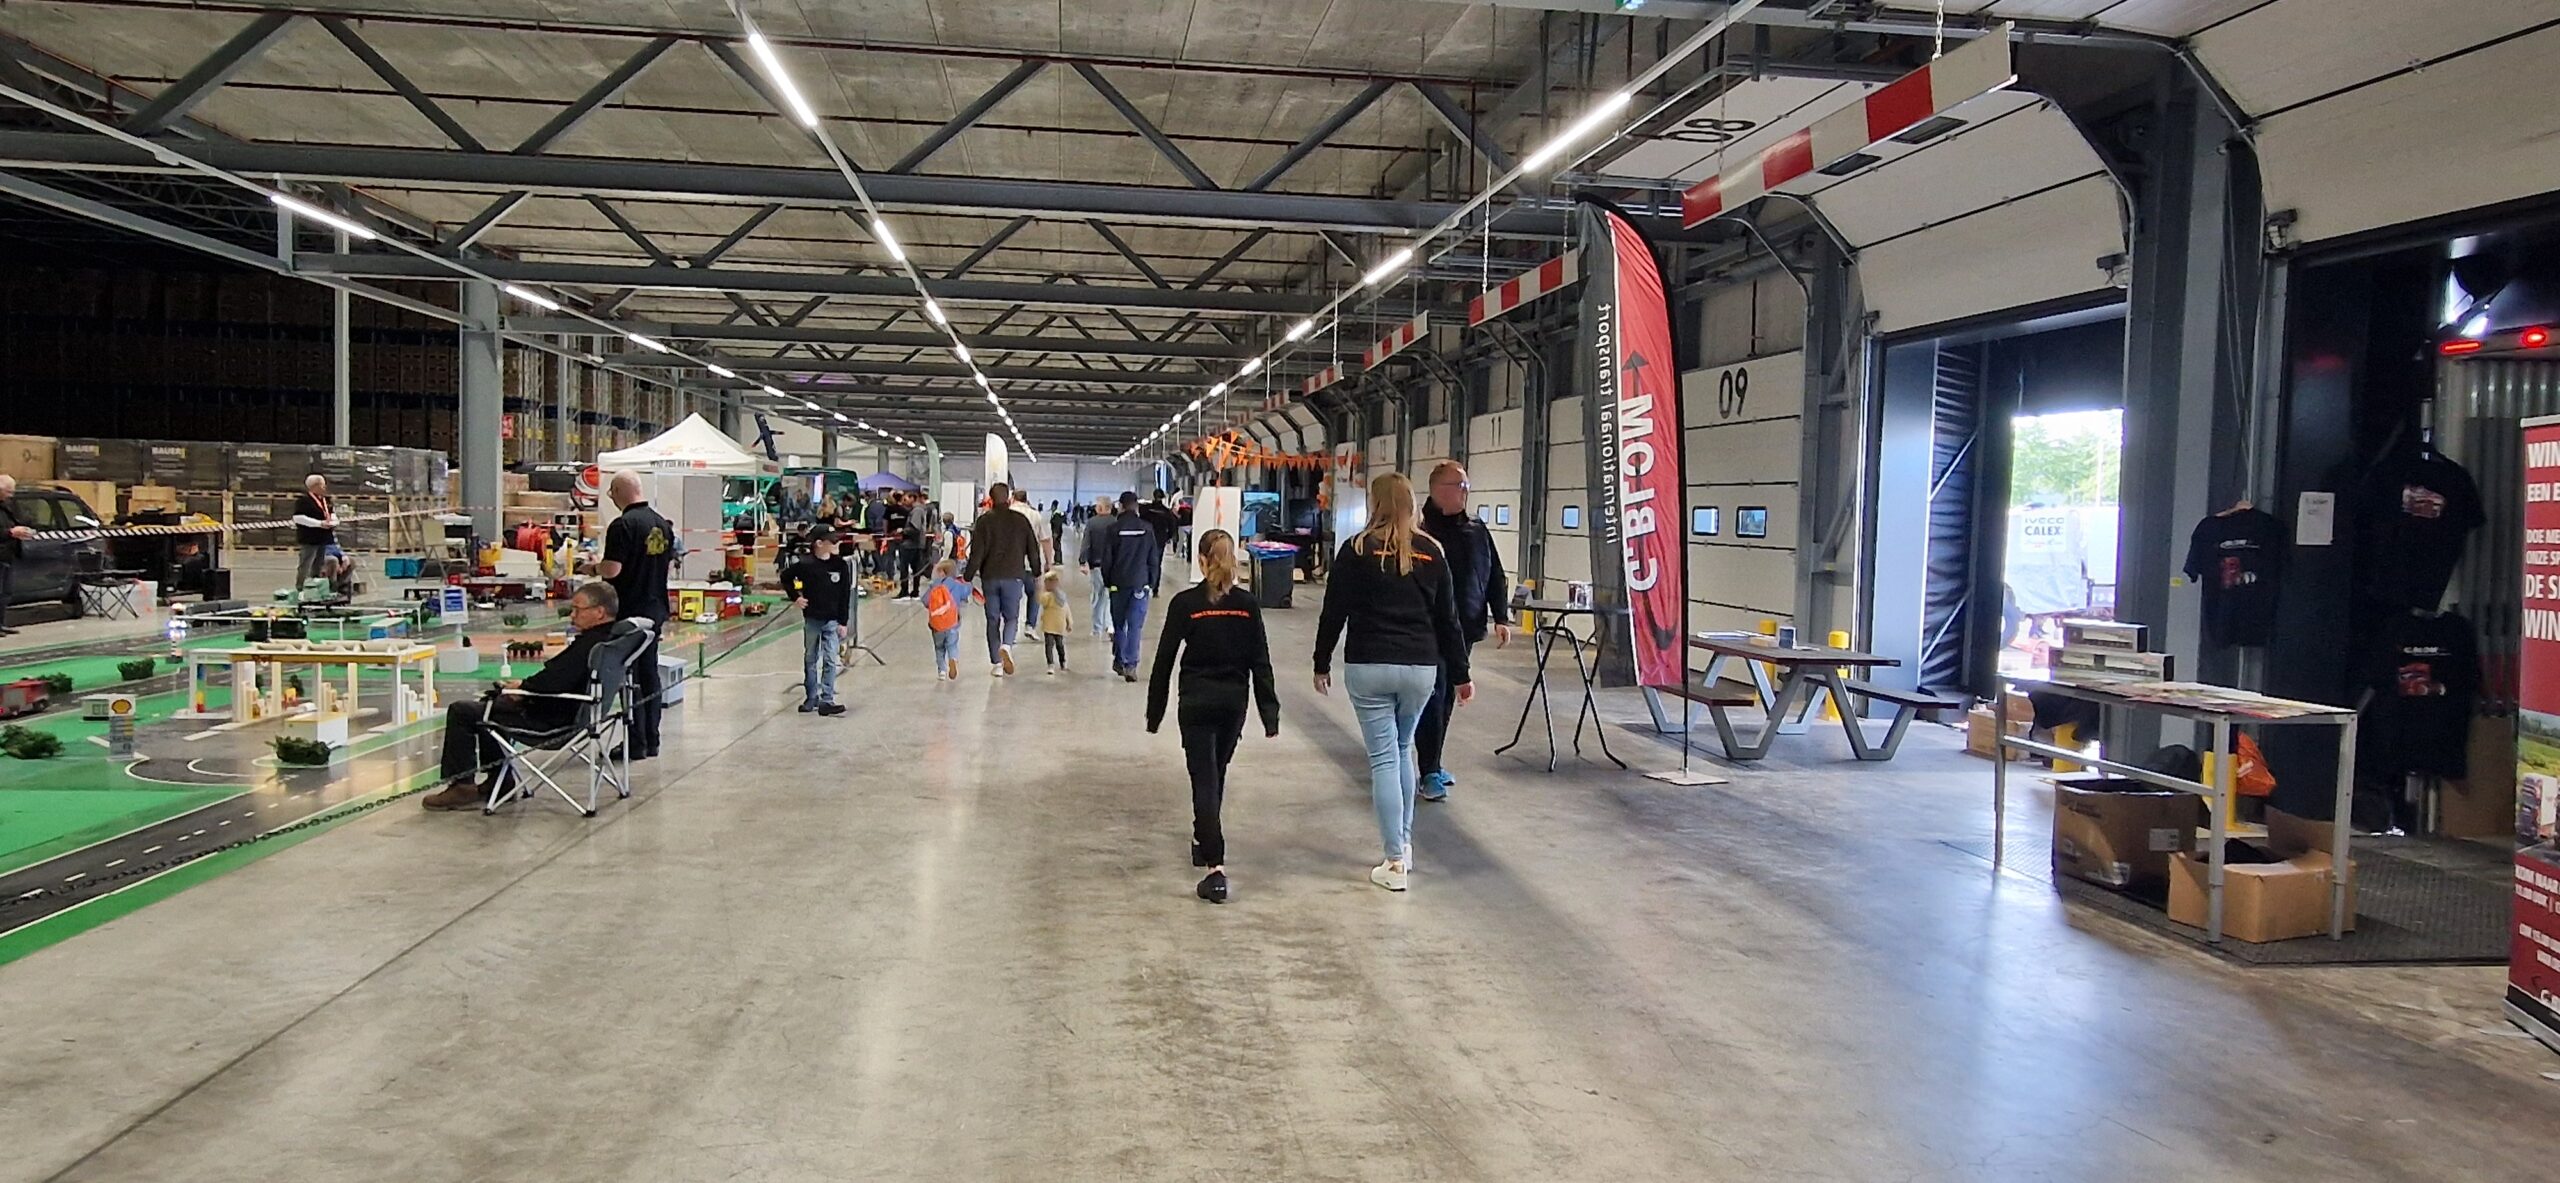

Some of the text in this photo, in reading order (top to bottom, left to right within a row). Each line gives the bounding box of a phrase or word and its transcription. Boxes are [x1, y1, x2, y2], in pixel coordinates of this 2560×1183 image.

[1664, 118, 1757, 143] 08
[1719, 367, 1748, 419] 09
[1491, 415, 1502, 447] 11
[65, 444, 96, 453] BAUER
[151, 446, 182, 455] BAUER
[1427, 429, 1436, 456] 12
[237, 450, 266, 458] BAUER
[320, 452, 350, 460] BAUER
[2528, 482, 2550, 502] EEN
[2024, 525, 2061, 536] CALEX
[2526, 528, 2545, 544] DOE
[2526, 550, 2549, 566] ONZE
[2525, 574, 2545, 599] DE
